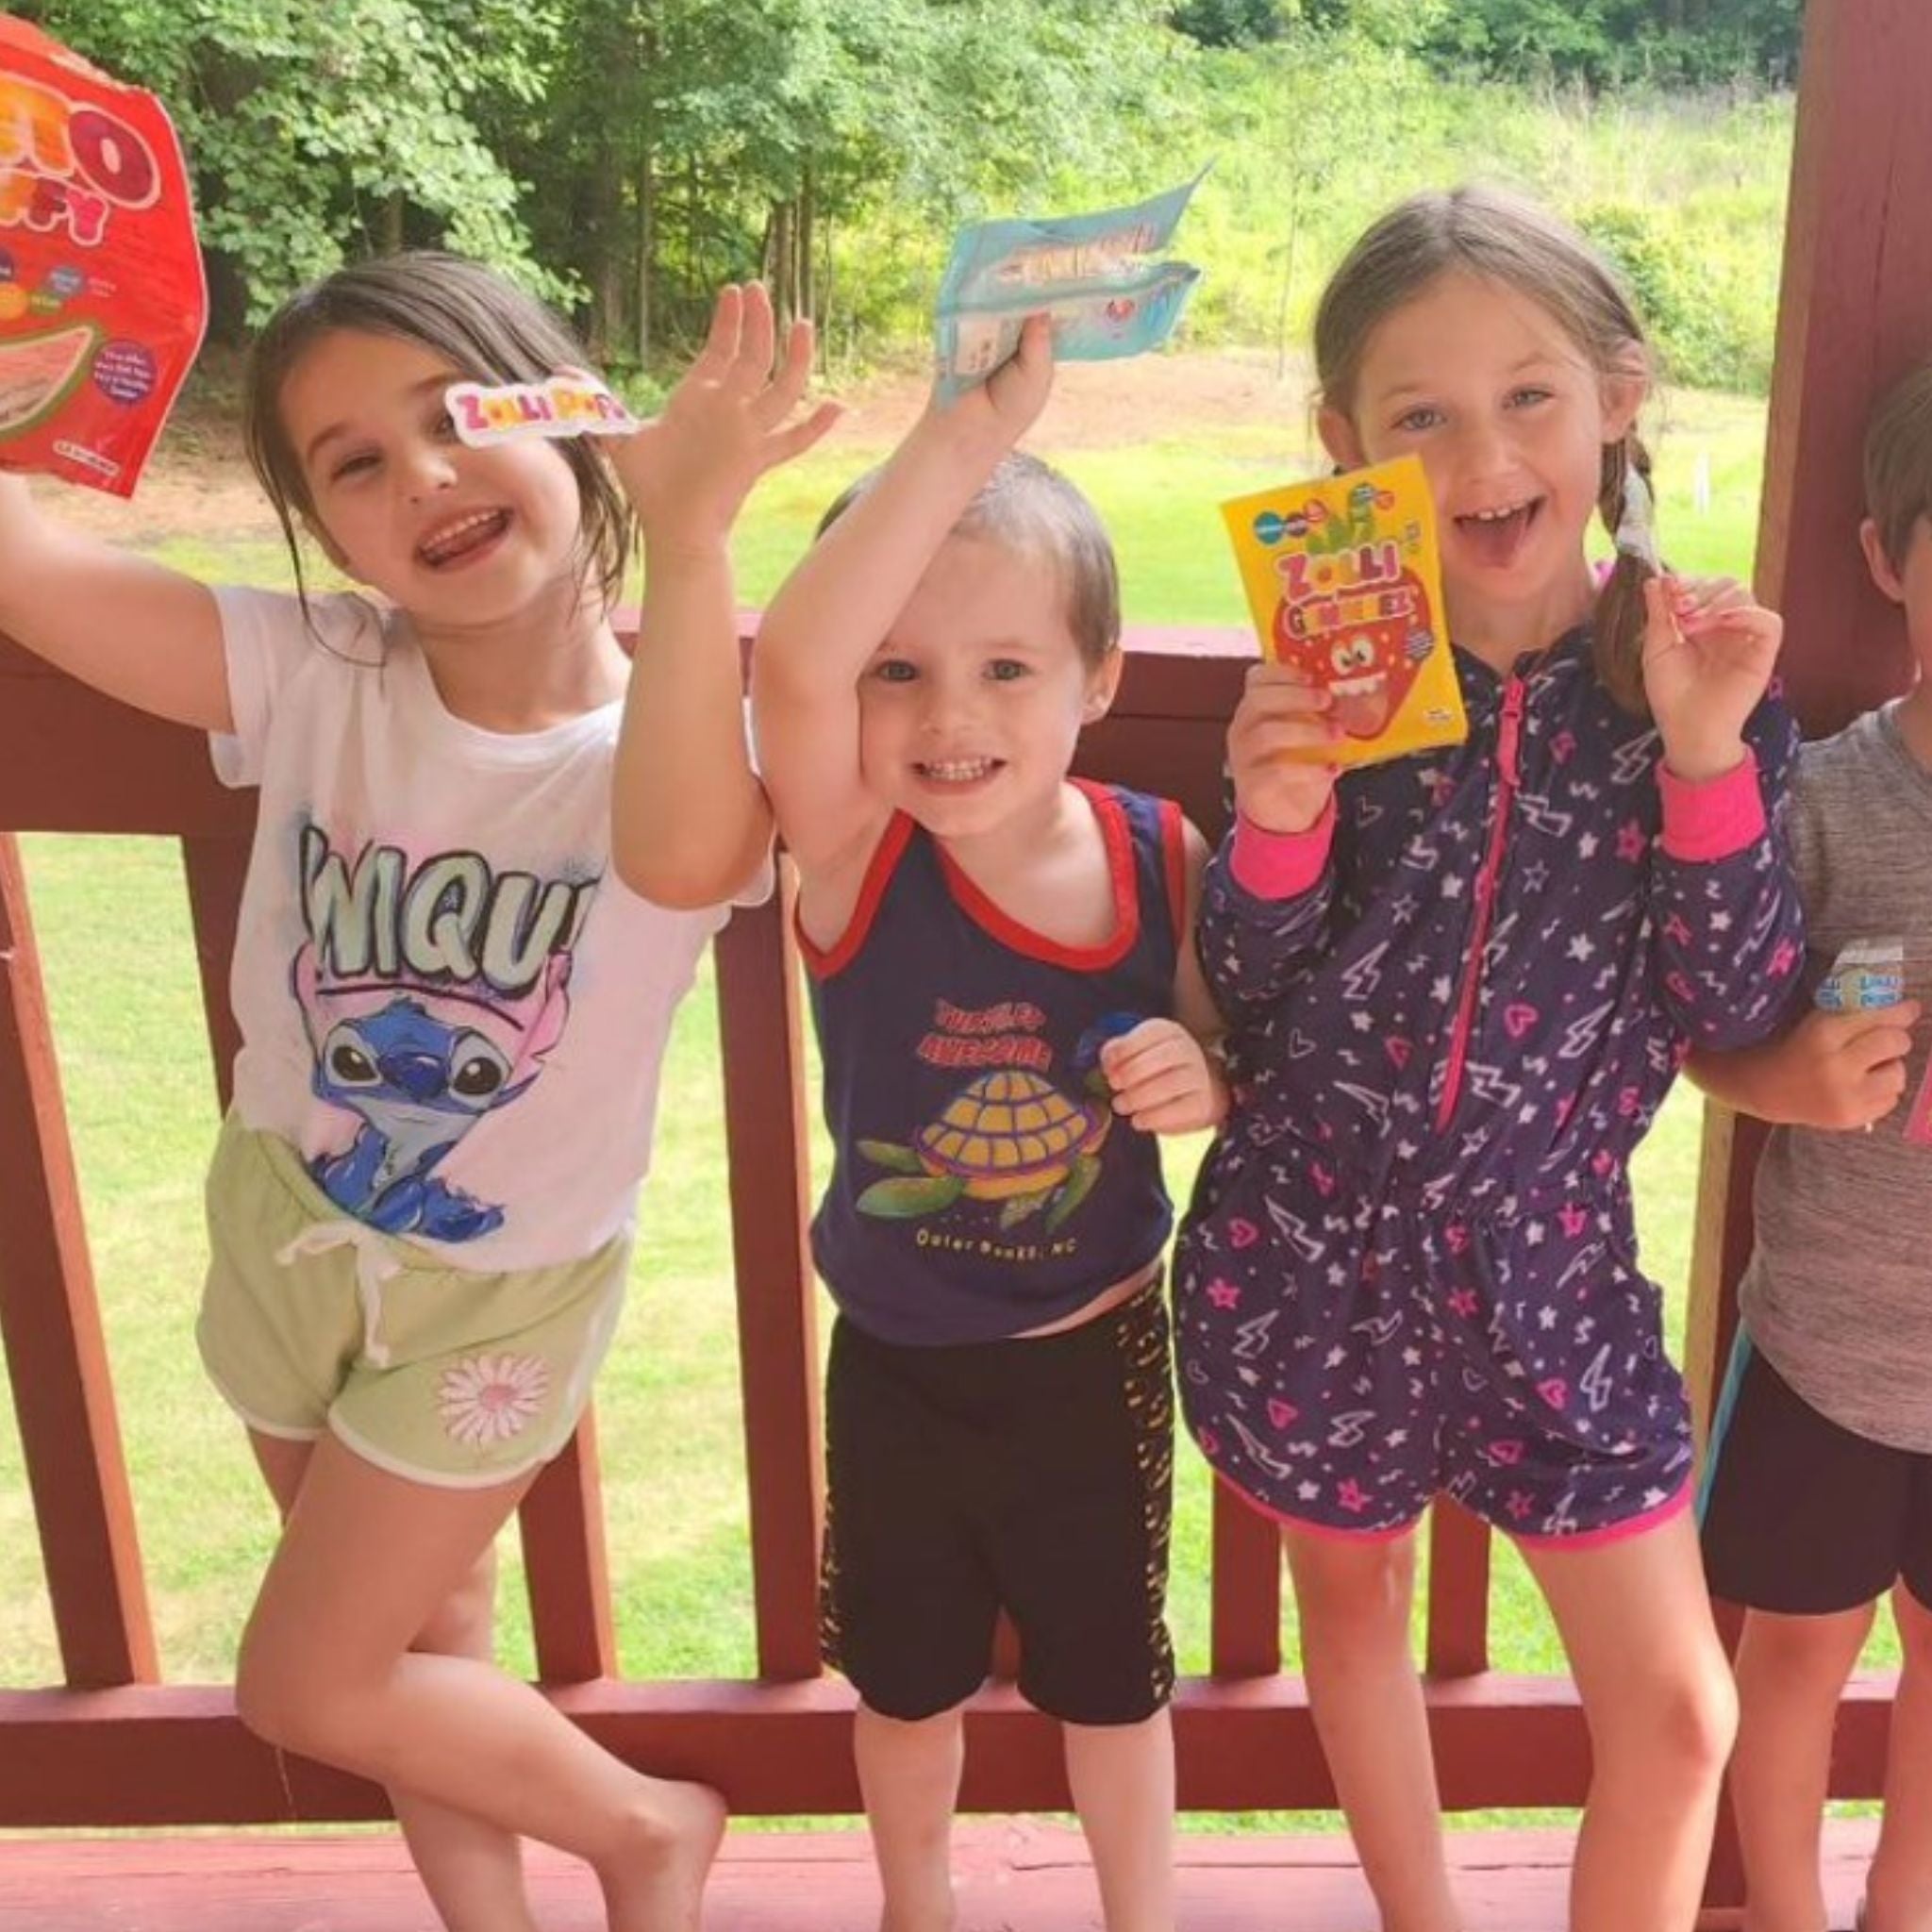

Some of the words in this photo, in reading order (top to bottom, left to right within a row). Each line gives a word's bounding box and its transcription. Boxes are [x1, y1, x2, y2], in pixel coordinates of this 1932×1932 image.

[456, 393, 552, 430] ZOLLI
[1277, 541, 1399, 602] ZOLLI
[299, 825, 601, 1001] NIQU
[916, 1227, 974, 1250] Outer
